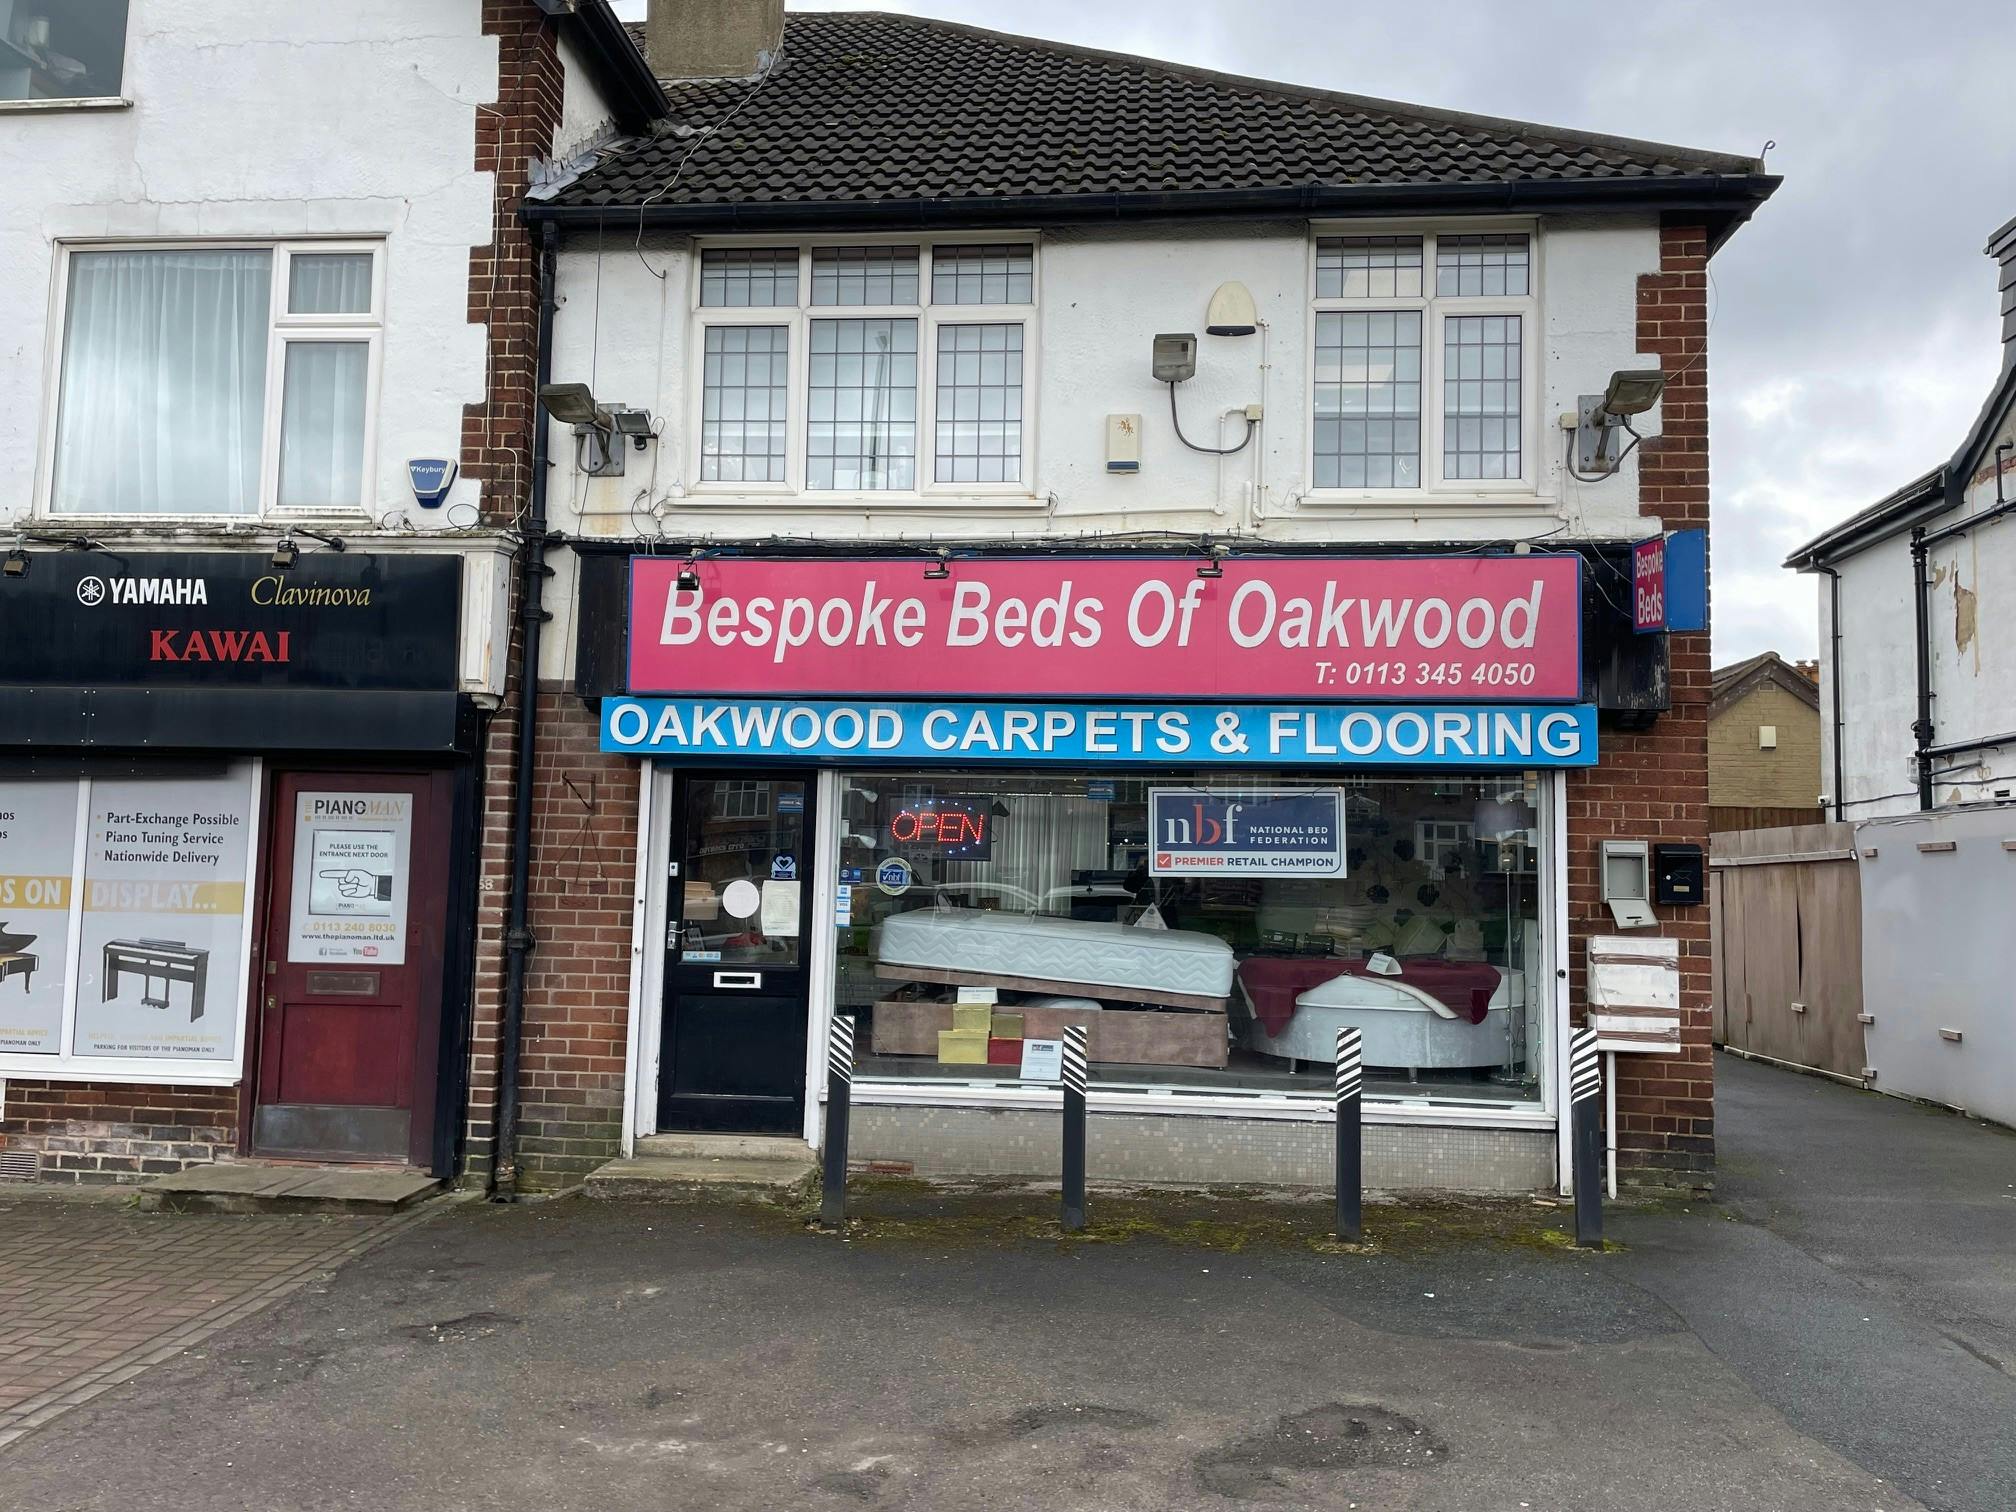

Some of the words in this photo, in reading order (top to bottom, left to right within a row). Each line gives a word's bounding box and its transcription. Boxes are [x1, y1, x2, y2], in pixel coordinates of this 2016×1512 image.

[416, 466, 445, 474] Keybury
[1636, 544, 1663, 582] Bespoke
[109, 577, 207, 605] YAMAHA
[250, 575, 371, 606] Clavinova
[1638, 584, 1662, 625] Beds
[659, 580, 926, 663] Bespoke
[946, 580, 1104, 647] Beds
[1127, 579, 1206, 648] Of
[1228, 579, 1544, 649] Oakwood
[150, 630, 290, 662] KAWAI
[1315, 662, 1336, 685] T:
[1346, 662, 1405, 685] 0113
[1415, 662, 1462, 685] 345
[1471, 662, 1536, 685] 4050
[609, 704, 904, 750] OAKWOOD
[923, 709, 1190, 754] CARPETS
[1209, 711, 1248, 754] &
[1270, 712, 1582, 756] FLOORING
[107, 812, 189, 827] Part-Exchange
[193, 813, 239, 825] Possible
[891, 812, 984, 842] OPEN
[1164, 801, 1243, 845] nbf
[1250, 826, 1304, 834] NATIONAL
[106, 831, 138, 843] Piano
[142, 832, 179, 846] Tuning
[183, 833, 224, 844] Service
[1250, 837, 1328, 845] FEDERATION
[104, 850, 169, 862] Nationwide
[173, 851, 219, 866] Delivery
[1175, 857, 1224, 866] PREMIER
[1227, 857, 1268, 866] RETAIL
[1271, 858, 1334, 867] CHAMPION
[25, 879, 61, 904] ON
